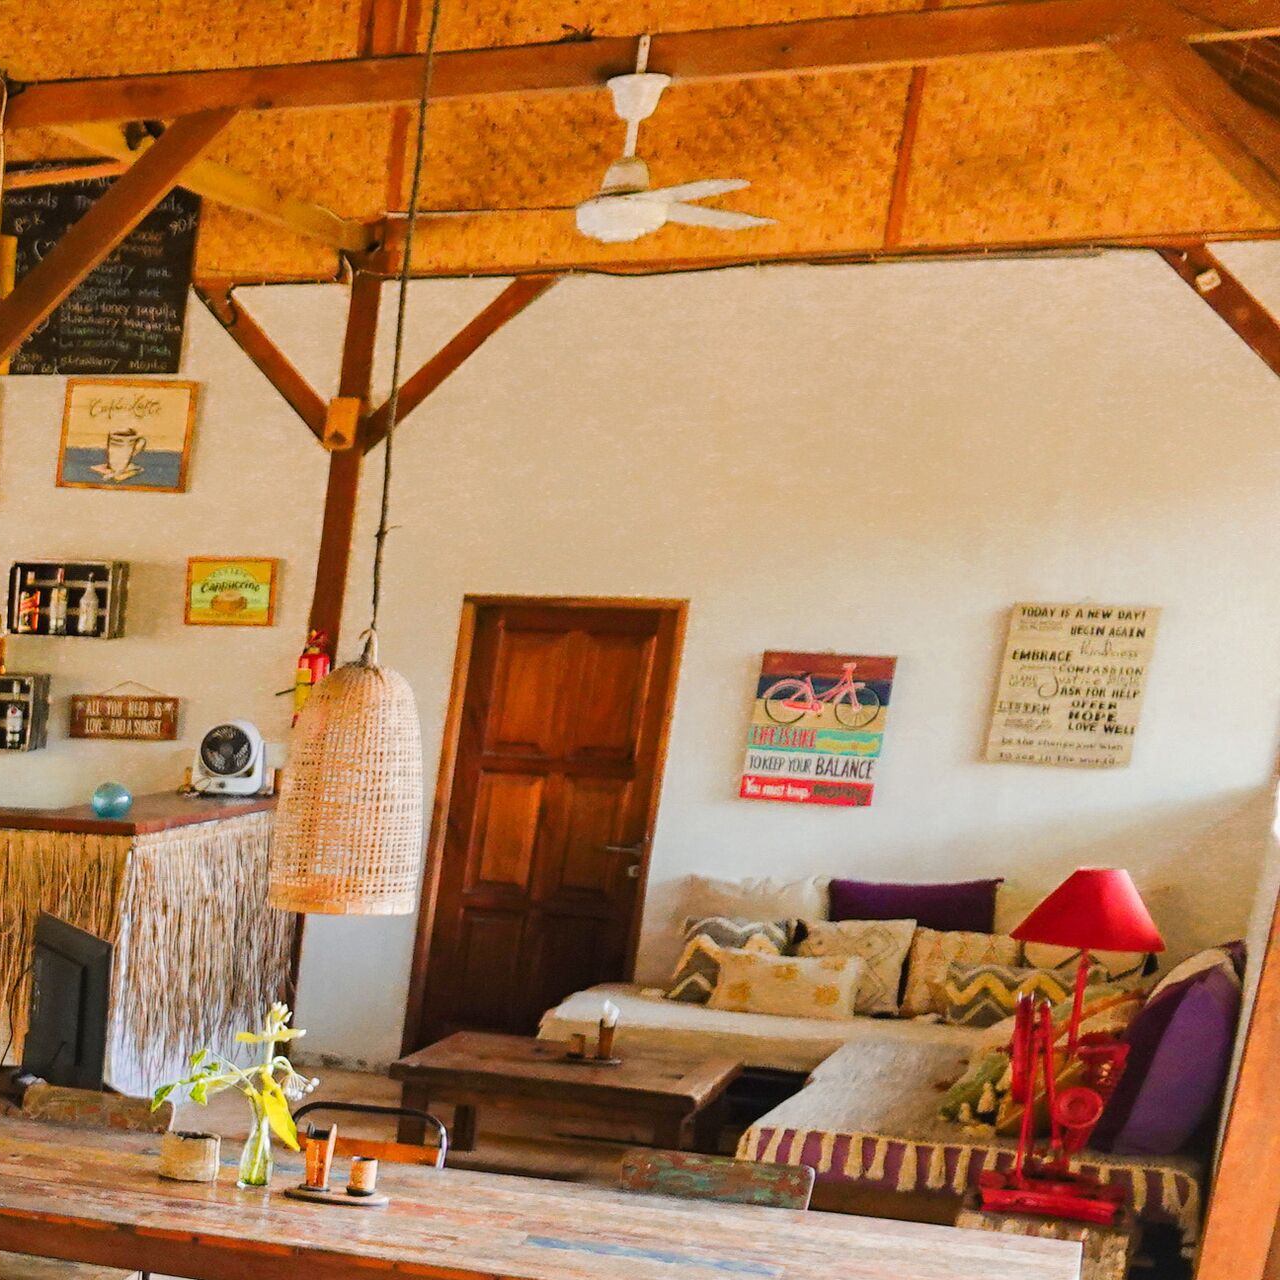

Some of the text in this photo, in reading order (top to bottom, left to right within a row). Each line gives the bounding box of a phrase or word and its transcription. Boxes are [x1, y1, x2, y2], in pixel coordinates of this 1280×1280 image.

[1020, 606, 1056, 618] TODAY
[1060, 607, 1072, 619] IS
[1074, 607, 1084, 619] A
[1087, 608, 1113, 620] NEW
[1069, 624, 1105, 637] BEGIN
[1108, 626, 1147, 639] AGAIN
[1011, 648, 1073, 663] EMBRACE
[1059, 686, 1082, 697] ASK
[1111, 688, 1142, 700] HELP
[85, 700, 101, 718] ALL
[105, 700, 123, 717] YOU
[1067, 722, 1098, 733] LOVE
[1103, 724, 1136, 736] WELL
[749, 754, 763, 769] TO
[787, 756, 813, 774] YOUR
[815, 757, 876, 780] BALANCE
